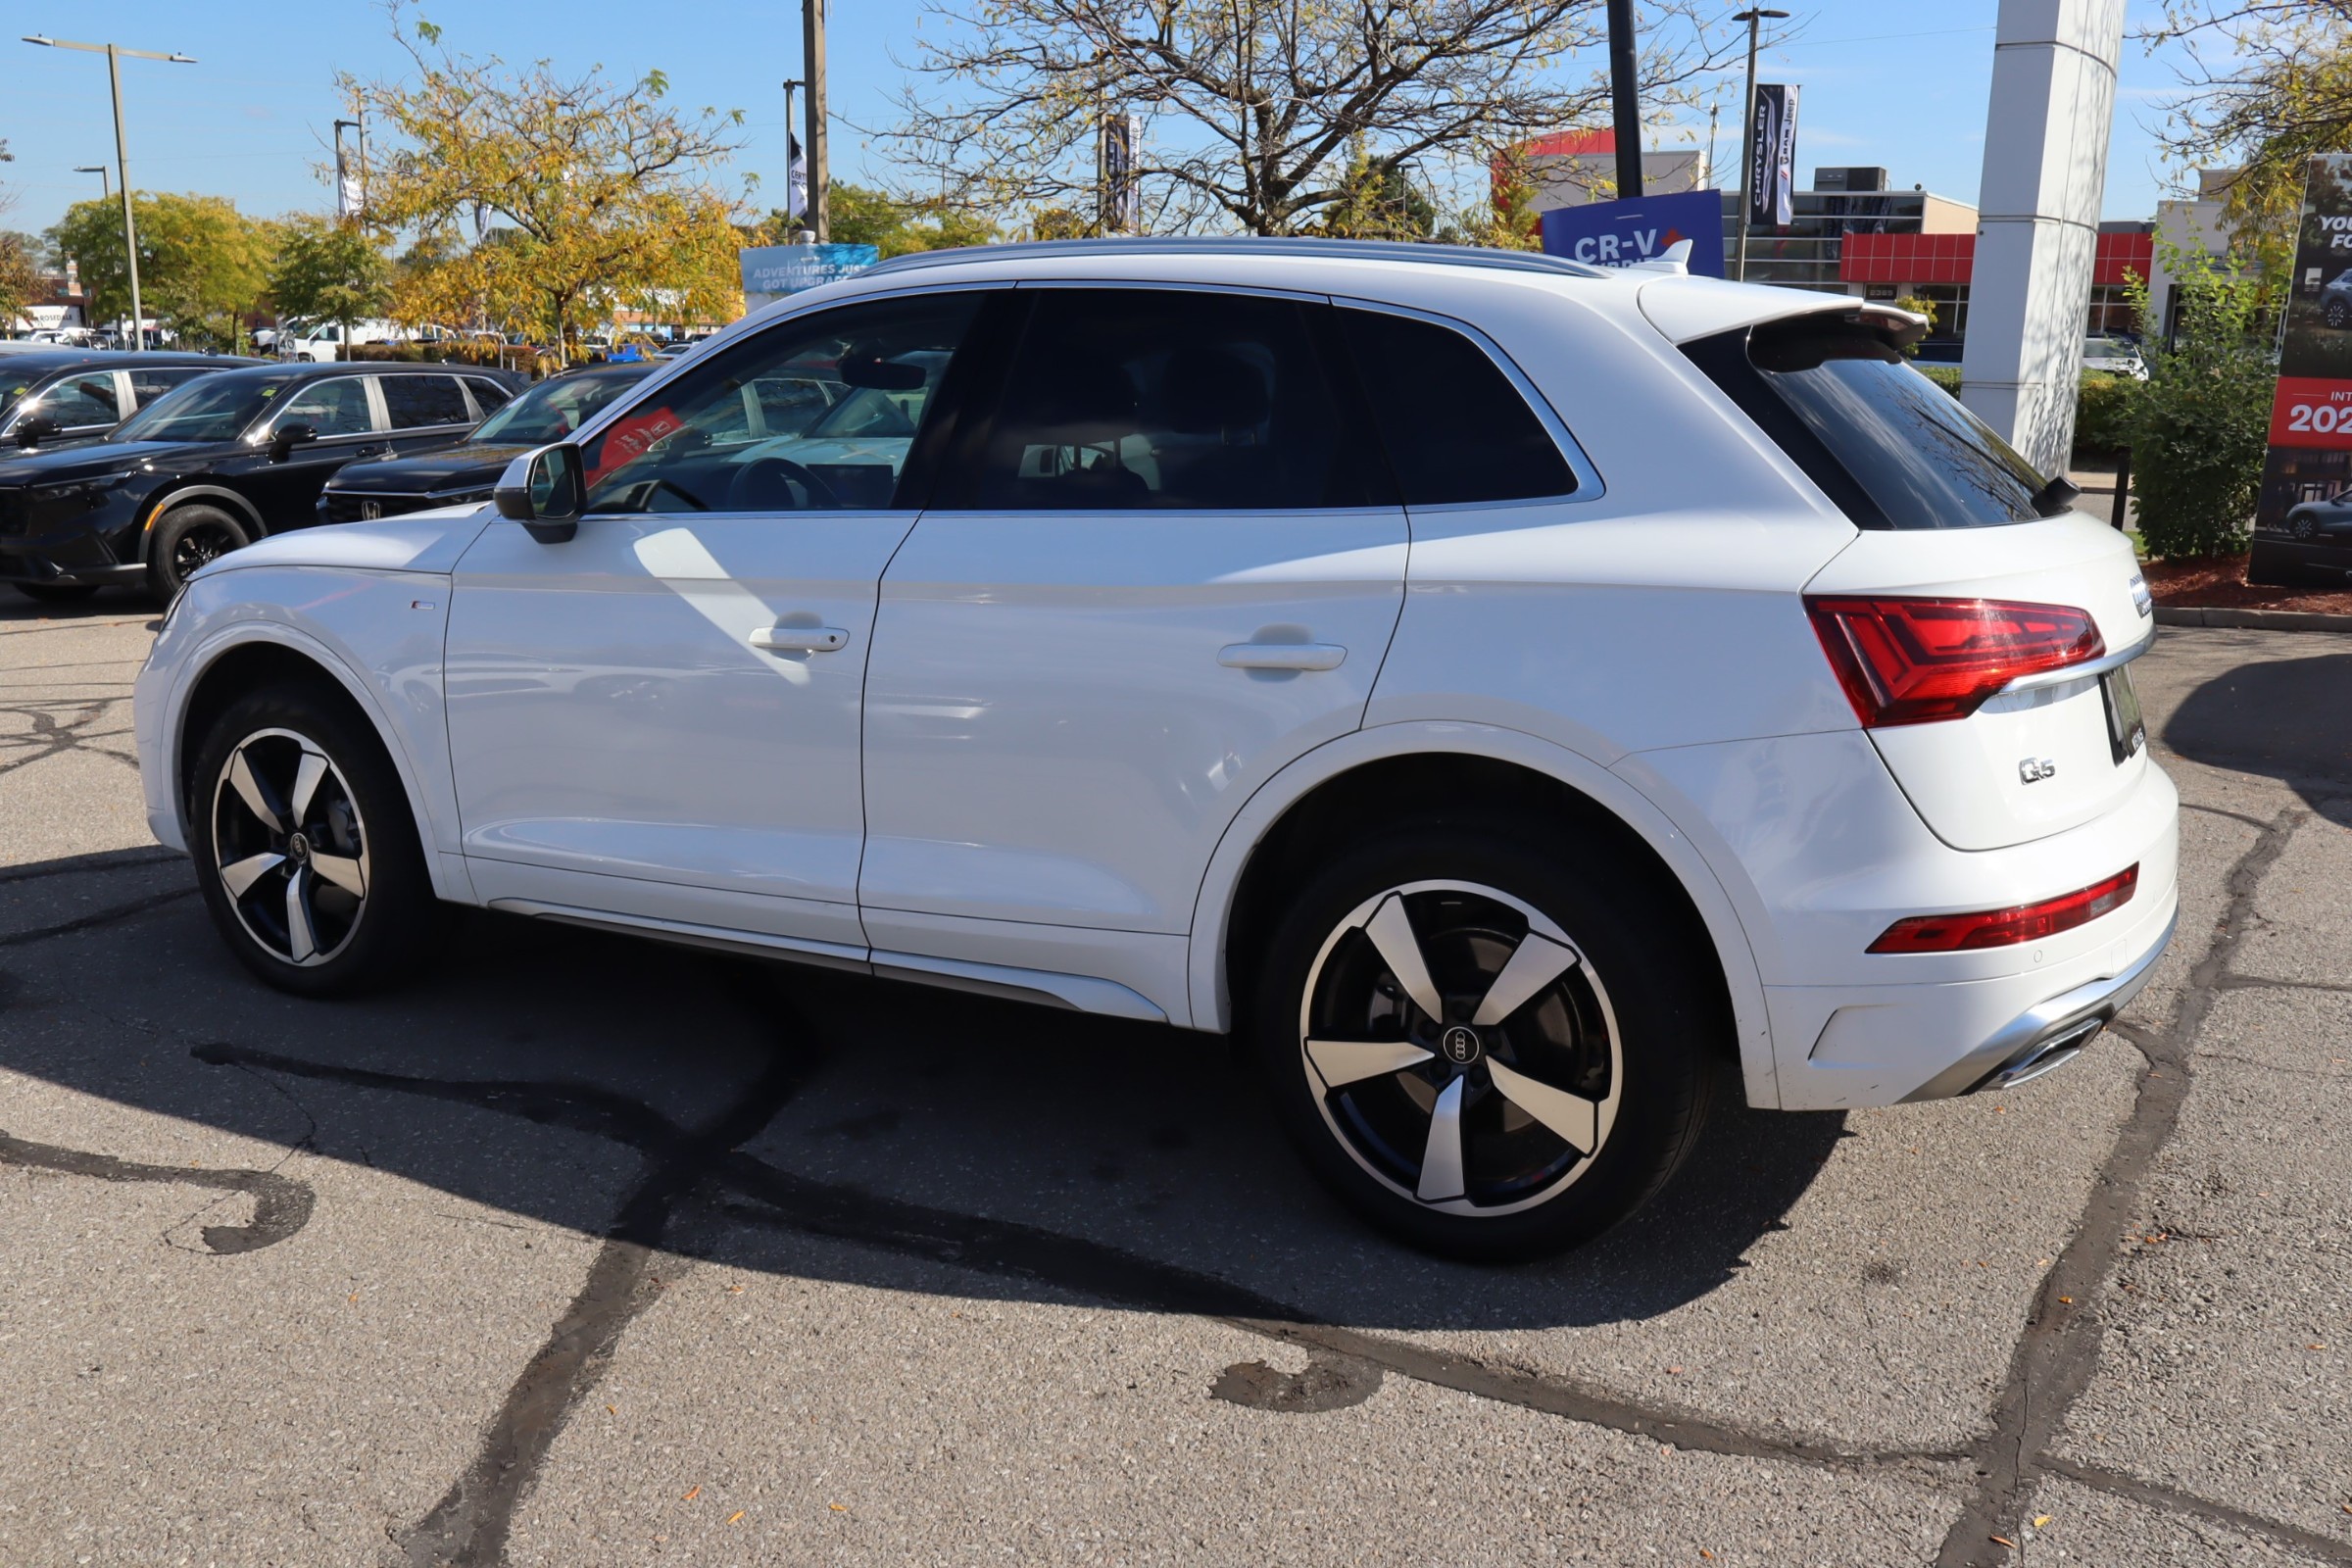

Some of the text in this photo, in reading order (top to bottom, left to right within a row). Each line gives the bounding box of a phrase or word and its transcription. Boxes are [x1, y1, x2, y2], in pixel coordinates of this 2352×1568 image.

[1784, 99, 1795, 125] Jeep
[1754, 105, 1767, 207] CHRYSLER
[1575, 229, 1657, 264] CR-V
[753, 264, 836, 279] ADVENTURES
[762, 278, 788, 290] GOT
[2019, 757, 2056, 785] Q5
